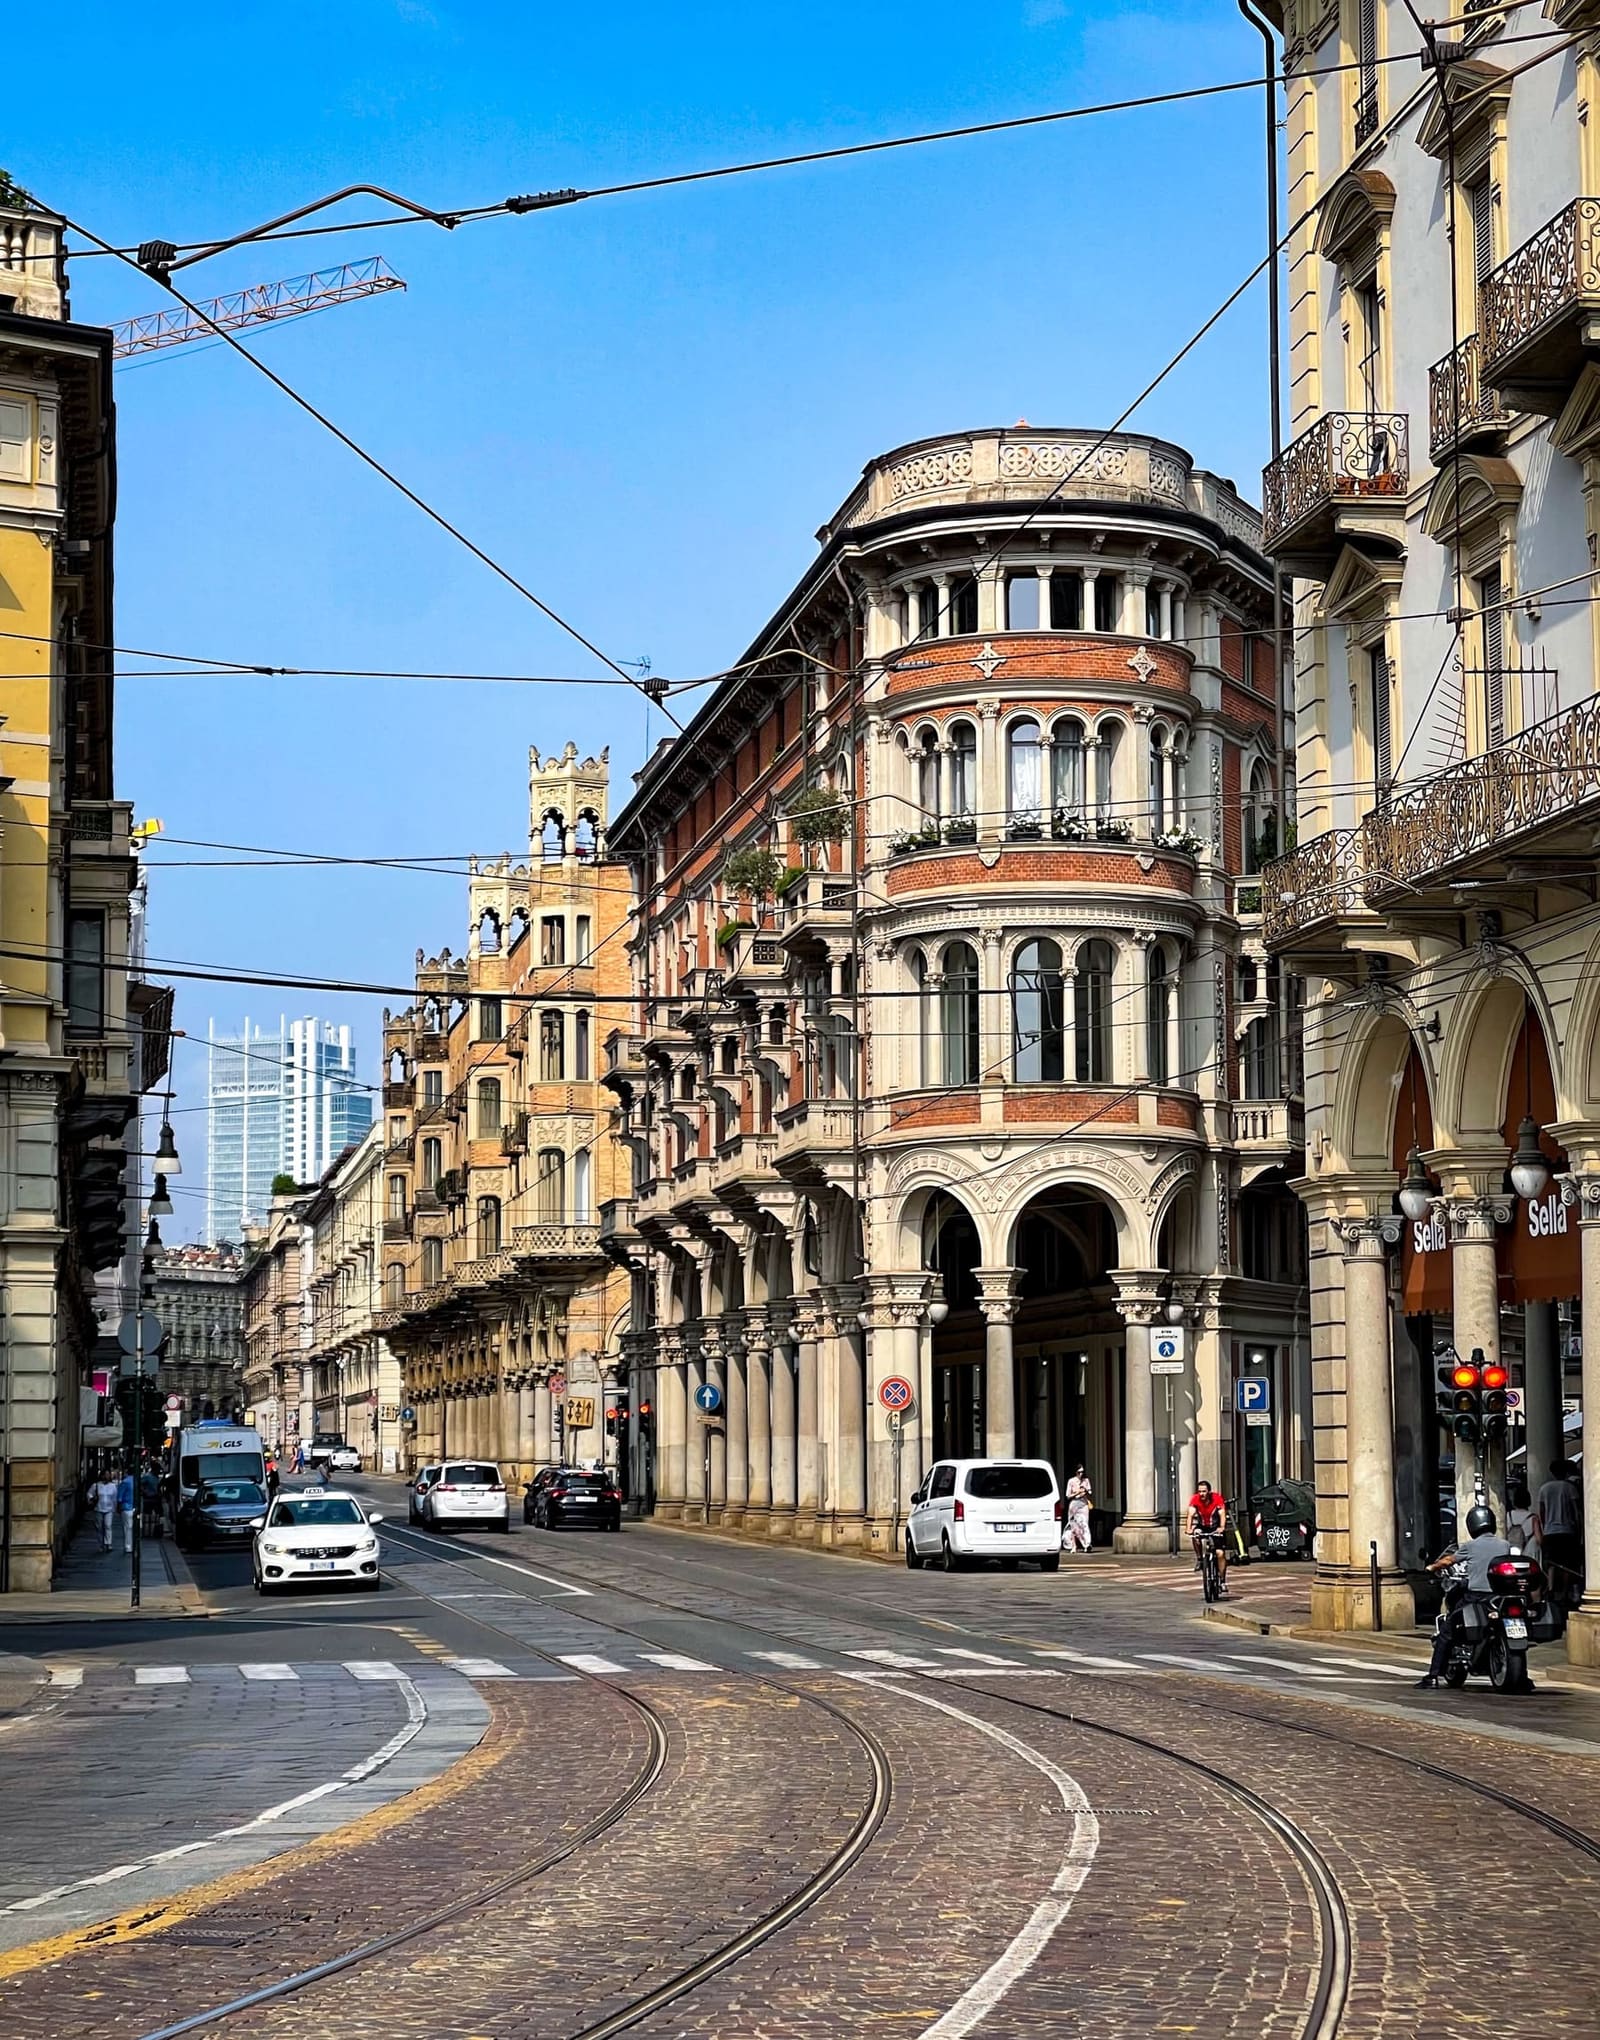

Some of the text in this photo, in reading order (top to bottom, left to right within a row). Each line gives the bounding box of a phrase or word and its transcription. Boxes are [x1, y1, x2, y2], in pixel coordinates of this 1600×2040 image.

[1528, 1194, 1568, 1237] Sella
[1413, 1215, 1447, 1253] Sella
[1243, 1382, 1261, 1408] P
[223, 1440, 243, 1448] GLS
